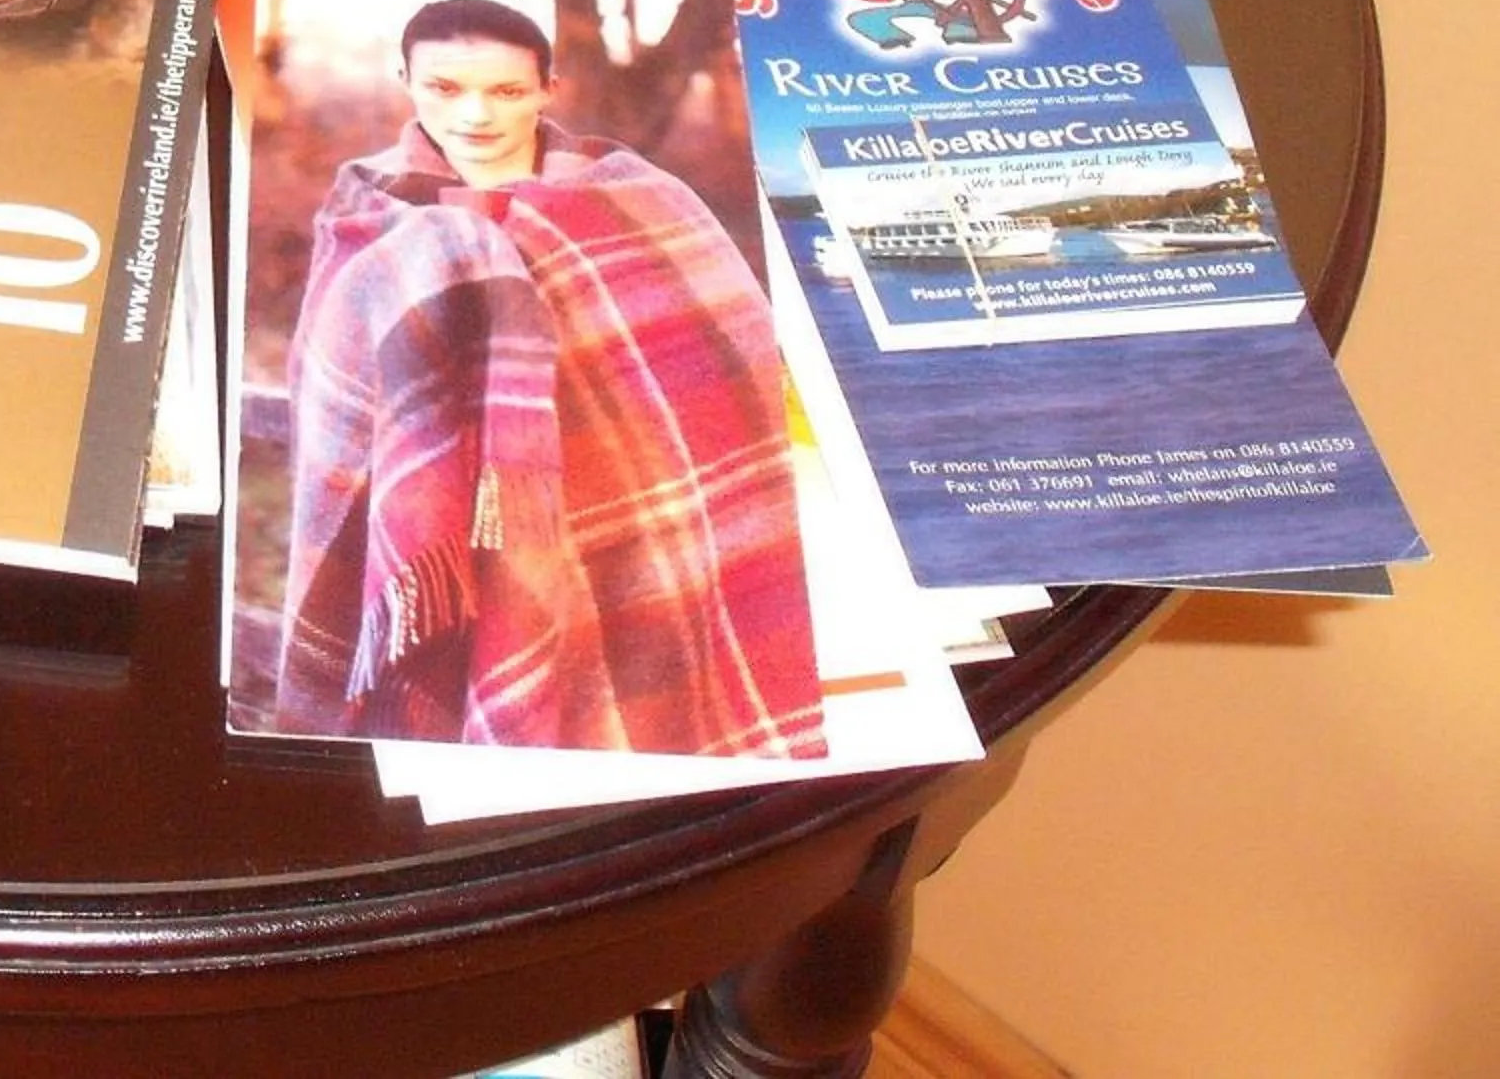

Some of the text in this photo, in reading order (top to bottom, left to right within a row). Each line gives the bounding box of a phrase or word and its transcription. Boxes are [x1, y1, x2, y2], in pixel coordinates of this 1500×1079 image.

[910, 286, 962, 301] Please
[966, 283, 1016, 300] pone
[1018, 280, 1041, 293] for
[1043, 275, 1101, 290] today's
[1103, 271, 1151, 285] times:
[909, 437, 1356, 474] For more information Phone James on 086 8140559
[945, 478, 983, 494] Fax:
[989, 477, 1020, 492] 061
[1108, 470, 1162, 487] email:
[1168, 460, 1338, 484] whelans@killaloe.ie
[965, 497, 1039, 515] website:
